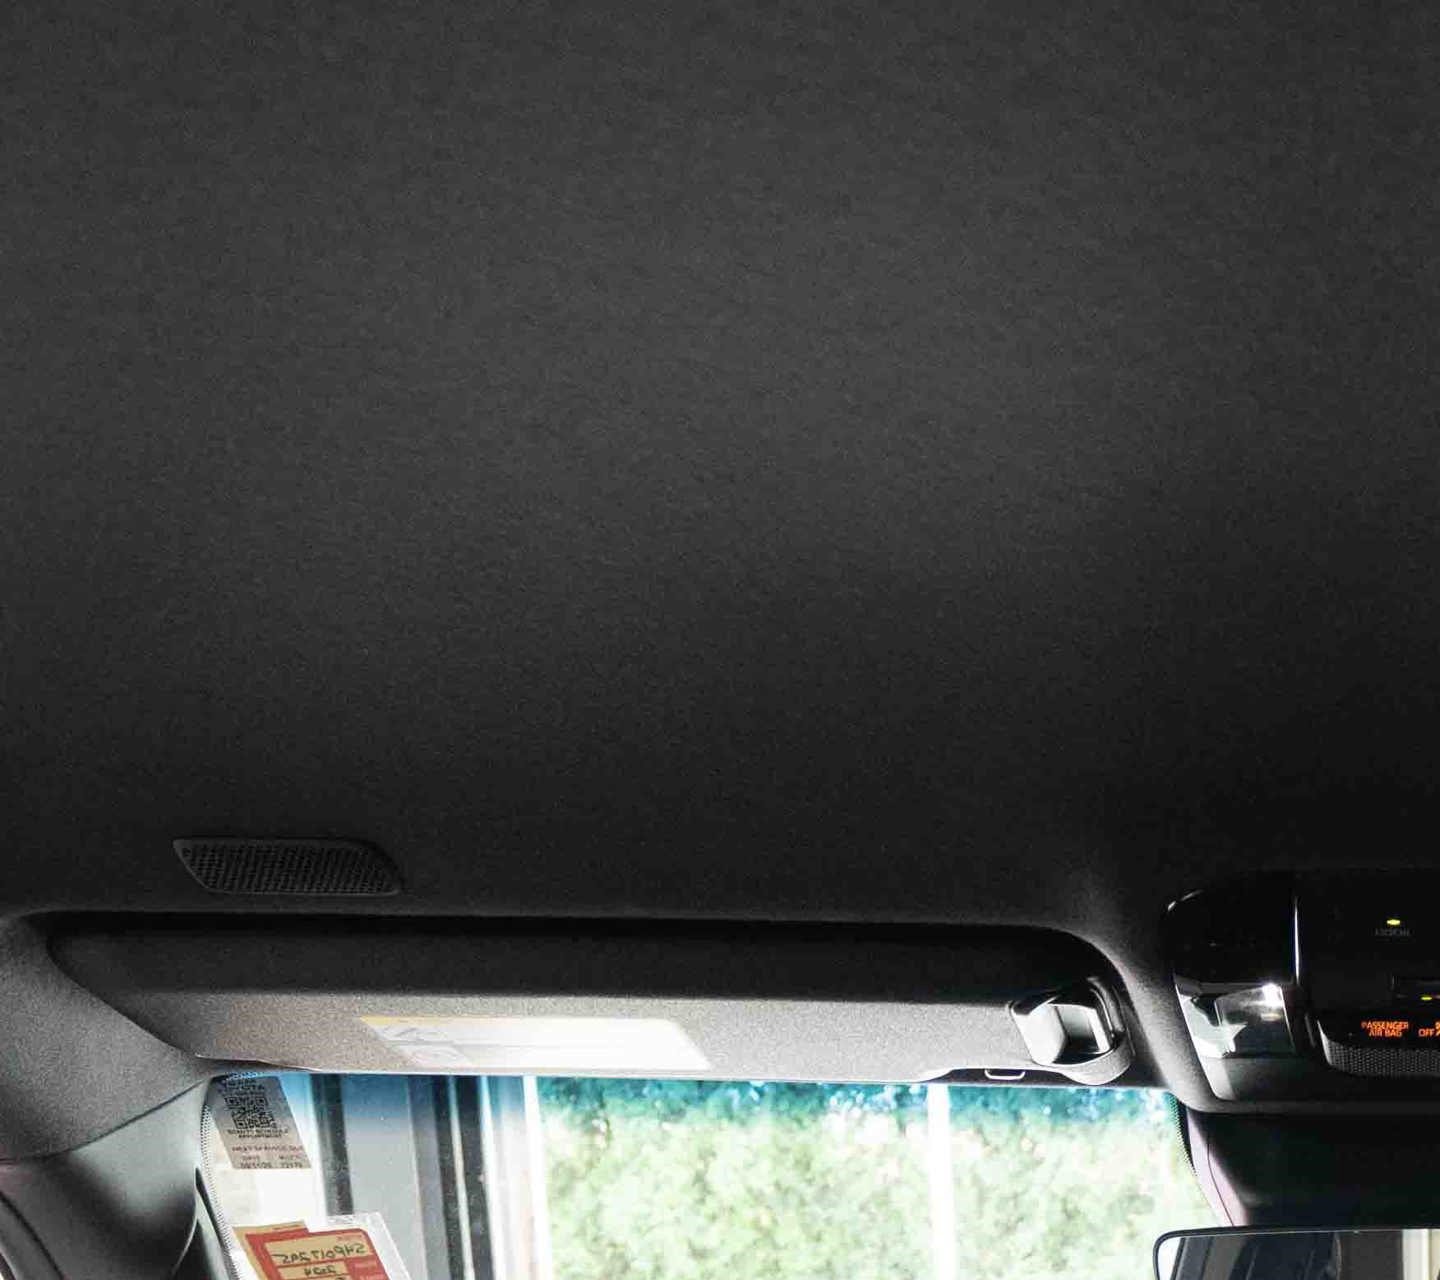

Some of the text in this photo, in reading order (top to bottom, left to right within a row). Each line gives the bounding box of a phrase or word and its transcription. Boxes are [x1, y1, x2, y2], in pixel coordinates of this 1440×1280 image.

[1361, 1021, 1409, 1030] PASSENGER
[1369, 1029, 1402, 1037] AIR BAG
[1418, 1028, 1435, 1037] OFF
